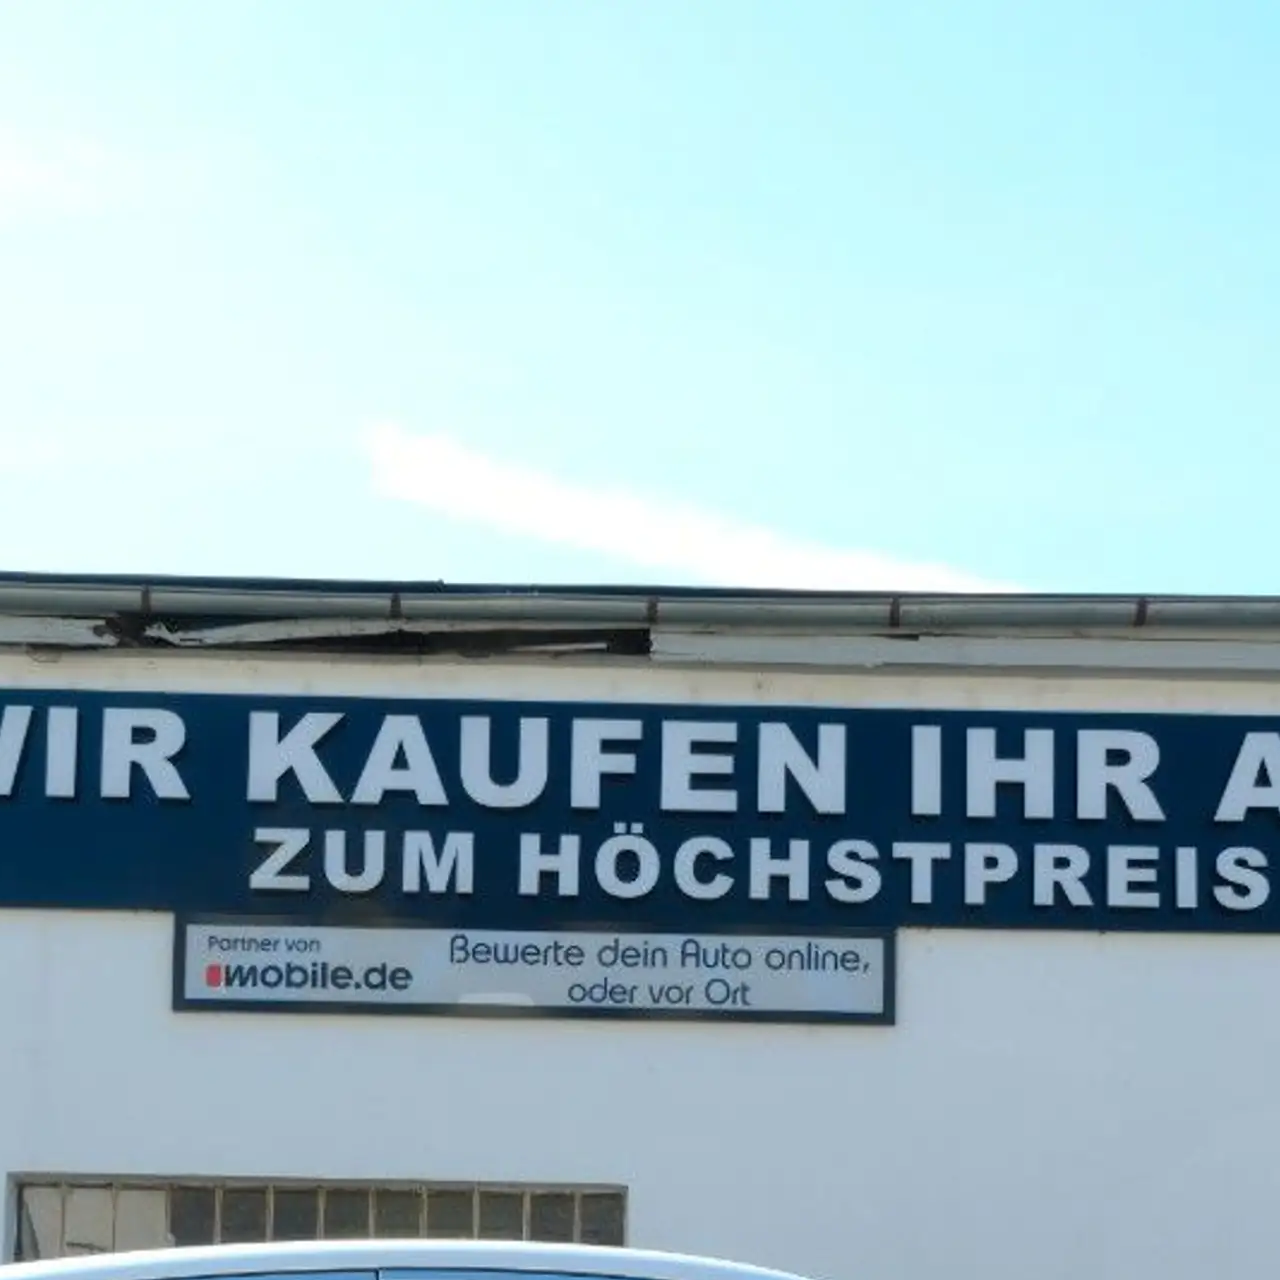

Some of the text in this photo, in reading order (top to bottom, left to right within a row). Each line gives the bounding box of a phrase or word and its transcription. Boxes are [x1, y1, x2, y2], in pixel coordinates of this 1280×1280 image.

[248, 712, 846, 814] KAUFEN
[913, 726, 1166, 821] IHR
[250, 822, 1271, 910] ZUM HÖCHSTPREIS
[207, 936, 321, 951] Partner von
[449, 934, 870, 973] Bewerte dein Auto online,
[224, 961, 413, 990] mobile.de
[567, 976, 751, 1006] oder vor Ort
